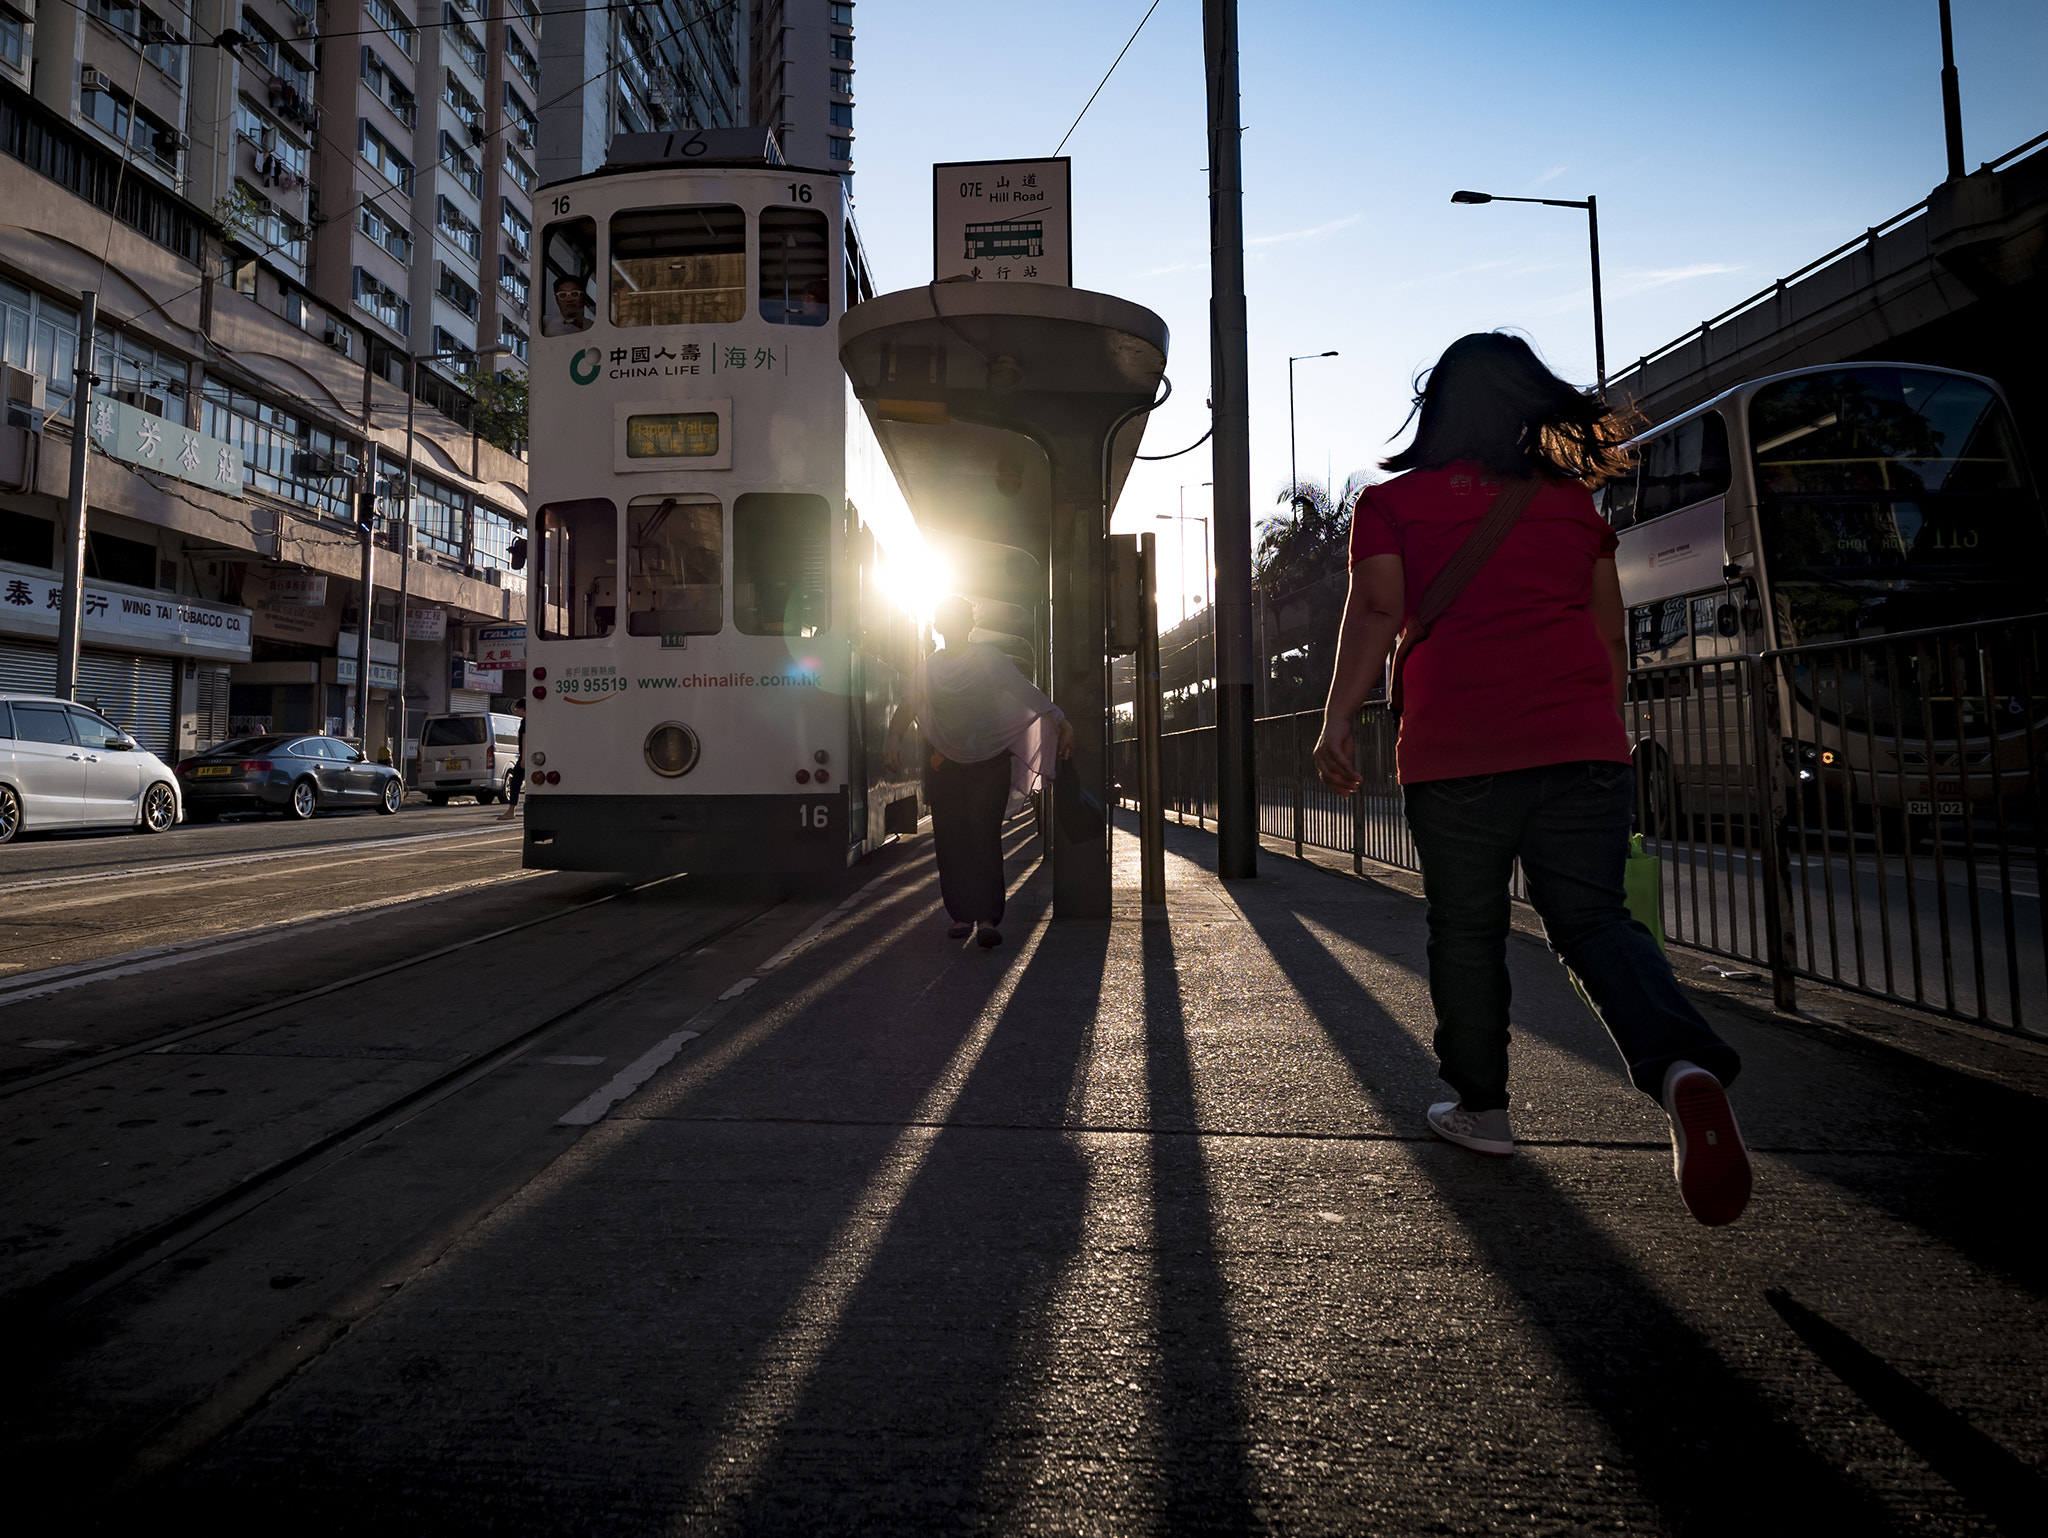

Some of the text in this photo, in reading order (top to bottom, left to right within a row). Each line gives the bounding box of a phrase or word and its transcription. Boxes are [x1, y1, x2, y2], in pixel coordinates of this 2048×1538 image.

[664, 132, 707, 157] 16
[996, 173, 1038, 188] 山道
[787, 183, 812, 203] 16
[960, 182, 982, 198] 07E
[990, 191, 1044, 203] Hill Road
[552, 195, 570, 215] 16
[971, 265, 1037, 280] 東行站
[609, 344, 777, 370] 中國人壽 海外
[609, 365, 701, 380] CHINA LIFE
[632, 420, 718, 438] Happy Valley
[122, 598, 242, 631] WING TAI TOBACCO CO.
[664, 635, 684, 646] 110
[555, 677, 627, 694] 399 95519
[637, 672, 822, 690] www.chinalife.com.hk
[799, 804, 829, 829] 16
[1911, 803, 1929, 814] RH
